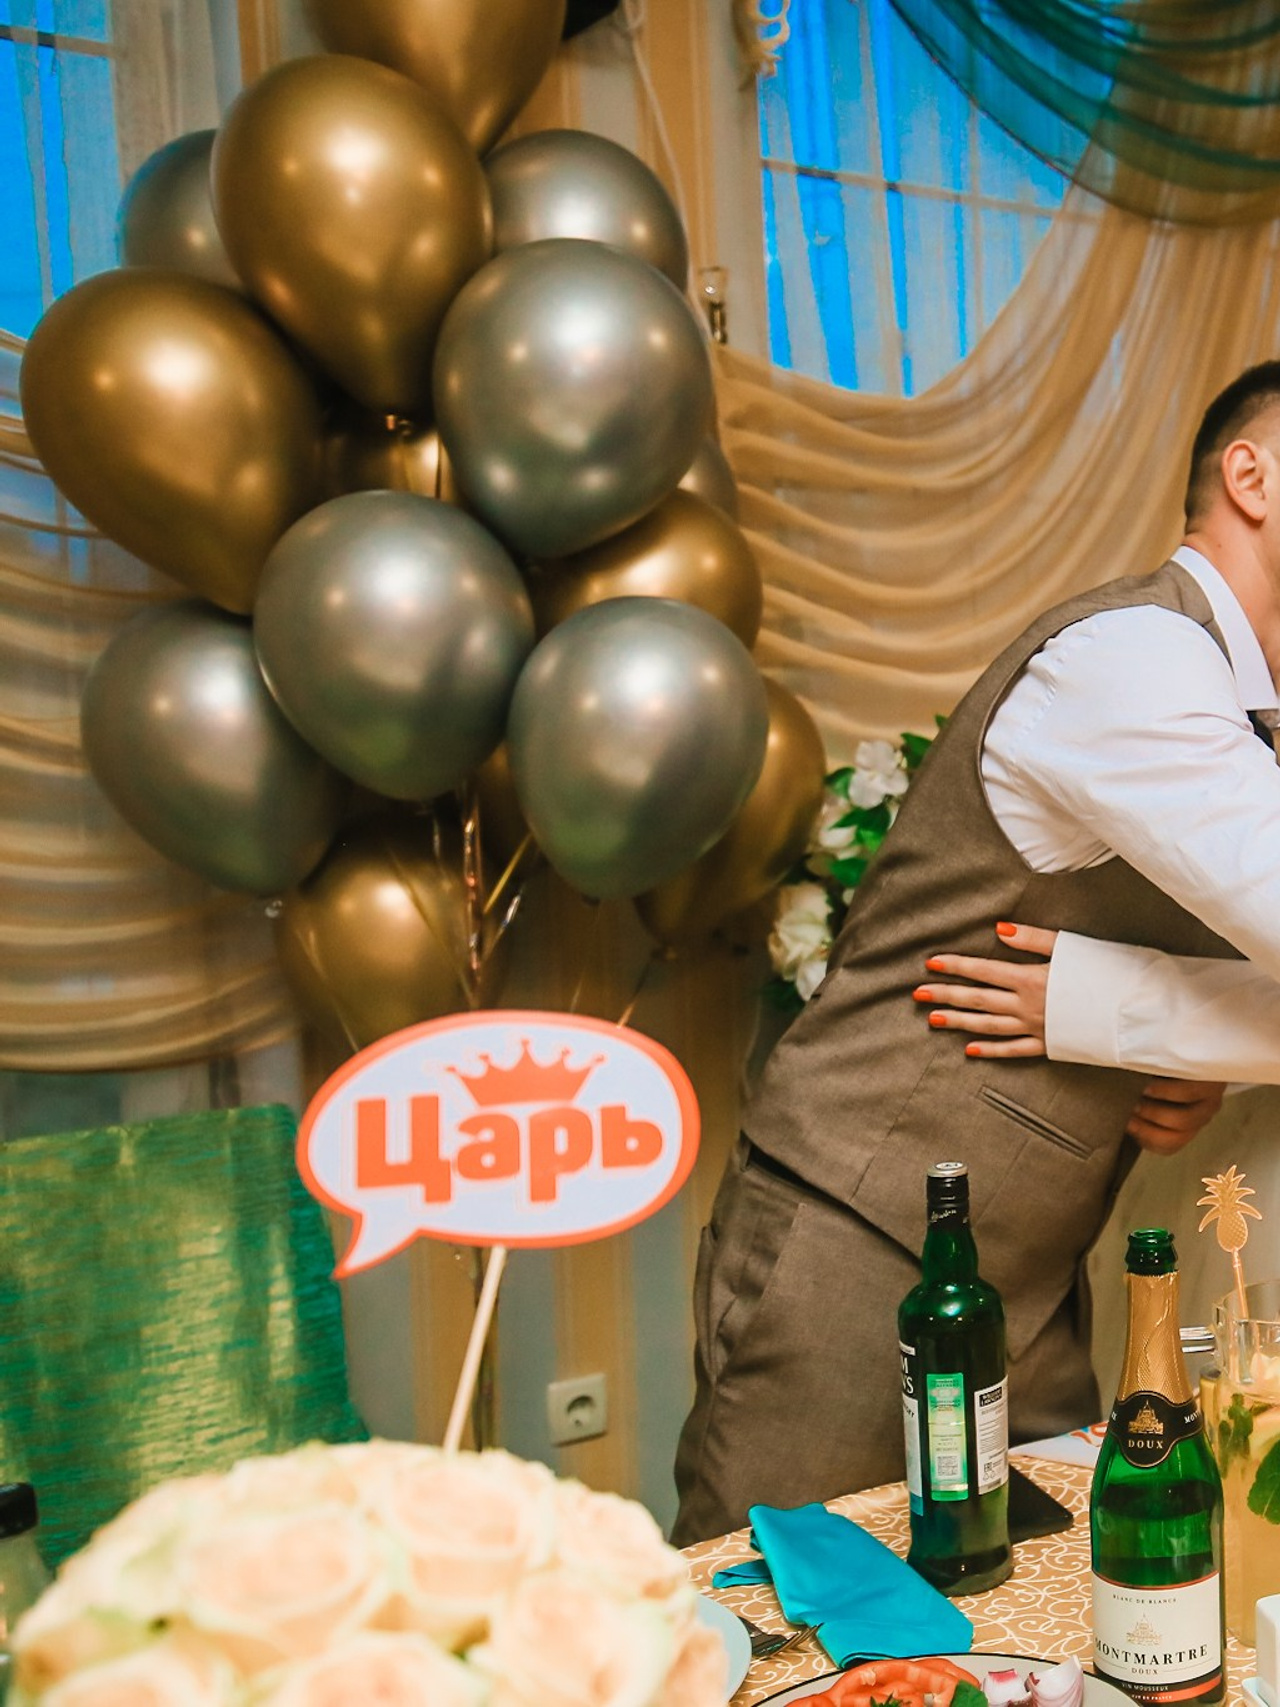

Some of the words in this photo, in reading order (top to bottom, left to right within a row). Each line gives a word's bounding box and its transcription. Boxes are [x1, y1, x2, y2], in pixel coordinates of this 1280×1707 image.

[356, 1093, 663, 1204] Царь
[1128, 1440, 1164, 1449] DOUX
[1095, 1637, 1208, 1665] MONTMARTRE
